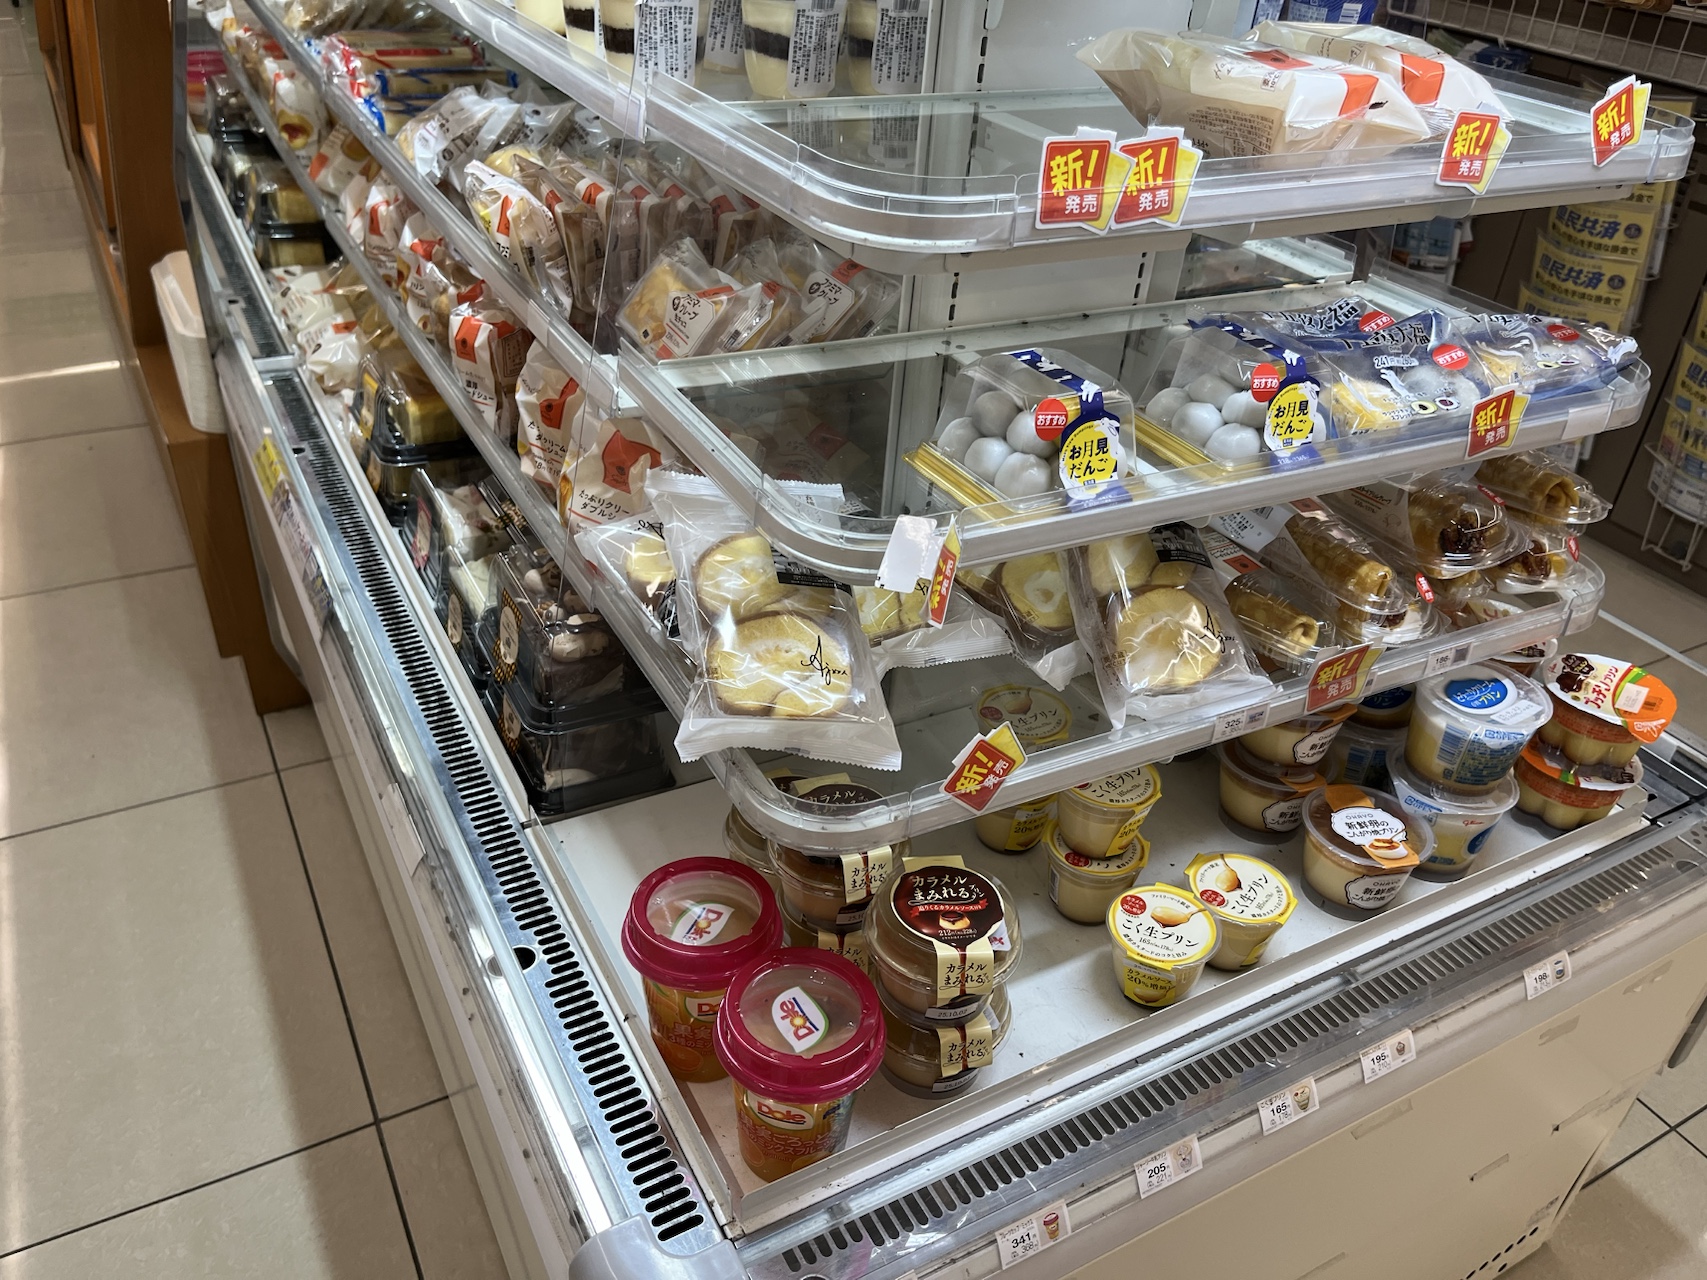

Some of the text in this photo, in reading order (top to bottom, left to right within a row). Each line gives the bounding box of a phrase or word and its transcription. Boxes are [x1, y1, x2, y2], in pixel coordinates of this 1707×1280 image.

[1596, 94, 1627, 142] 新!
[1452, 119, 1491, 159] 新!
[1610, 122, 1631, 147] 発売
[1050, 148, 1099, 197] 新!
[1126, 147, 1168, 196] 新!
[1457, 159, 1482, 177] 発売
[1064, 194, 1097, 214] 発売
[1138, 189, 1169, 213] 発売
[1555, 203, 1622, 241] 県民共済
[1540, 252, 1606, 291] 県民共済
[1364, 316, 1391, 332] おすすめ
[1437, 349, 1465, 365] おすすめ
[1253, 377, 1279, 389] おすすめ
[1274, 400, 1309, 419] お月見
[1476, 397, 1507, 437] 新!
[1036, 414, 1067, 426] おすすめ
[1272, 418, 1307, 437] だんご
[1485, 425, 1506, 446] 発売
[1069, 437, 1109, 460] お月見
[1069, 458, 1108, 479] だんご
[579, 489, 630, 514] たっぷりクリー
[581, 501, 616, 520] ダブルシ
[1317, 654, 1359, 690] 新!
[1327, 679, 1352, 699] 発売
[1480, 690, 1500, 705] プリン
[1011, 708, 1058, 729] く生プリン
[1224, 719, 1241, 729] 325
[955, 751, 994, 795] 新!
[983, 759, 1009, 790] 発売
[1091, 767, 1141, 798] こく生プリン
[1345, 819, 1389, 831] 新鮮卵の
[1346, 827, 1399, 838] こんがり焼プリン
[851, 862, 887, 878] カラメル
[912, 873, 968, 888] カラメル
[913, 884, 985, 901] まみれる プリン
[1231, 873, 1269, 914] こく生プリン
[695, 906, 724, 942] Dole
[1122, 919, 1199, 948] こく生プリン
[946, 963, 987, 974] カラメル
[1126, 968, 1173, 985] カラメルソース
[1534, 972, 1547, 983] 198
[943, 973, 986, 985] まみれる
[780, 996, 816, 1042] Dole
[948, 1039, 986, 1049] カラメル
[946, 1049, 985, 1062] まみれる
[1371, 1052, 1386, 1065] 195
[757, 1101, 807, 1122] Dole
[1270, 1102, 1287, 1116] 165
[1147, 1162, 1166, 1179] 205
[1011, 1232, 1031, 1248] 341
[1020, 1242, 1034, 1254] 368
